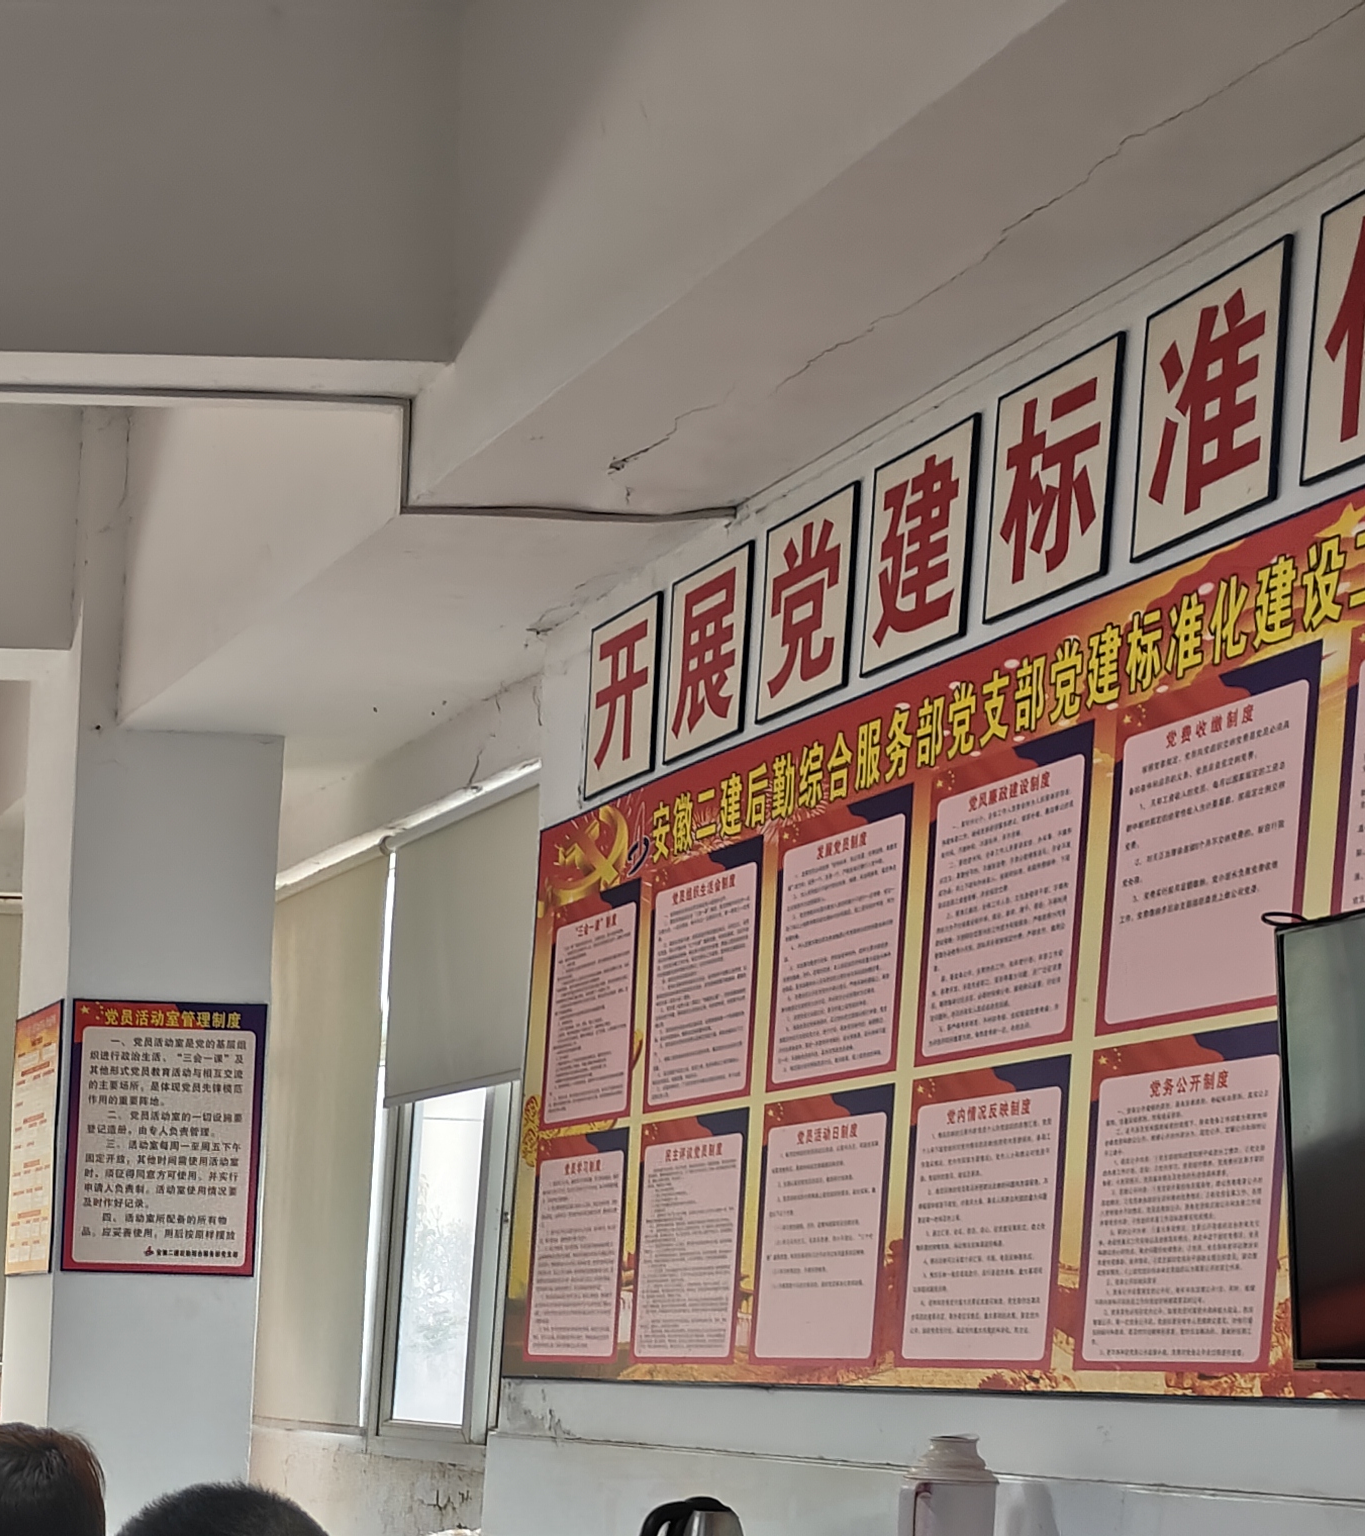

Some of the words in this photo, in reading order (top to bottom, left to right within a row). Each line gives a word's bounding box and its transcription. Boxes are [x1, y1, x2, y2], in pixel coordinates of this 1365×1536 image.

[652, 529, 1365, 863] 安徽二建后勤综合服务部党支部党建标准化建设
[1166, 703, 1254, 748] 党费收缴制度
[969, 771, 1051, 812] 党风廉政建设制度
[105, 1009, 241, 1029] 党员活动室管理制度
[1150, 1069, 1229, 1099] 党务公开制度
[946, 1099, 1031, 1125] 党内情况反映制度
[796, 1123, 858, 1145] 党员活动日制度
